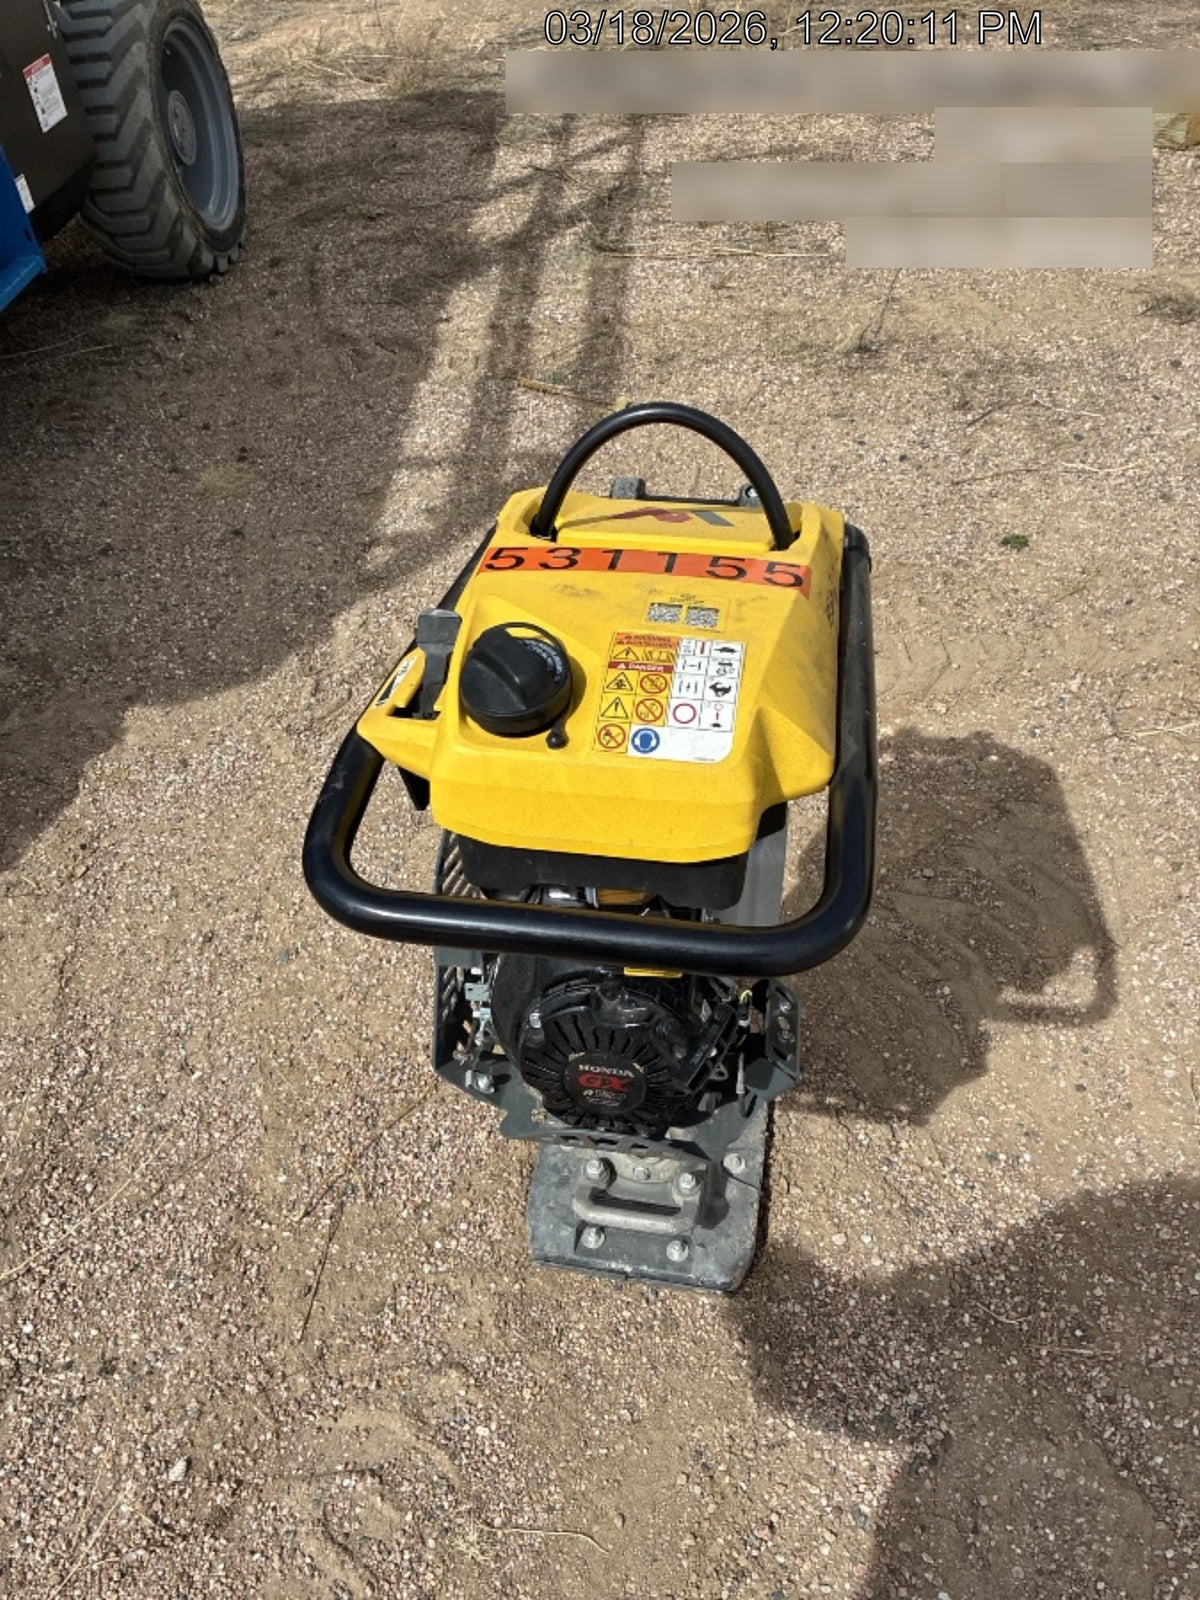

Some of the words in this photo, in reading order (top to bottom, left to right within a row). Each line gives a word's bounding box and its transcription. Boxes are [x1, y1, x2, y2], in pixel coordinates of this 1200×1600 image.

[485, 547, 804, 587] 531155
[579, 1064, 635, 1078] HONDA
[579, 1073, 631, 1092] GX
